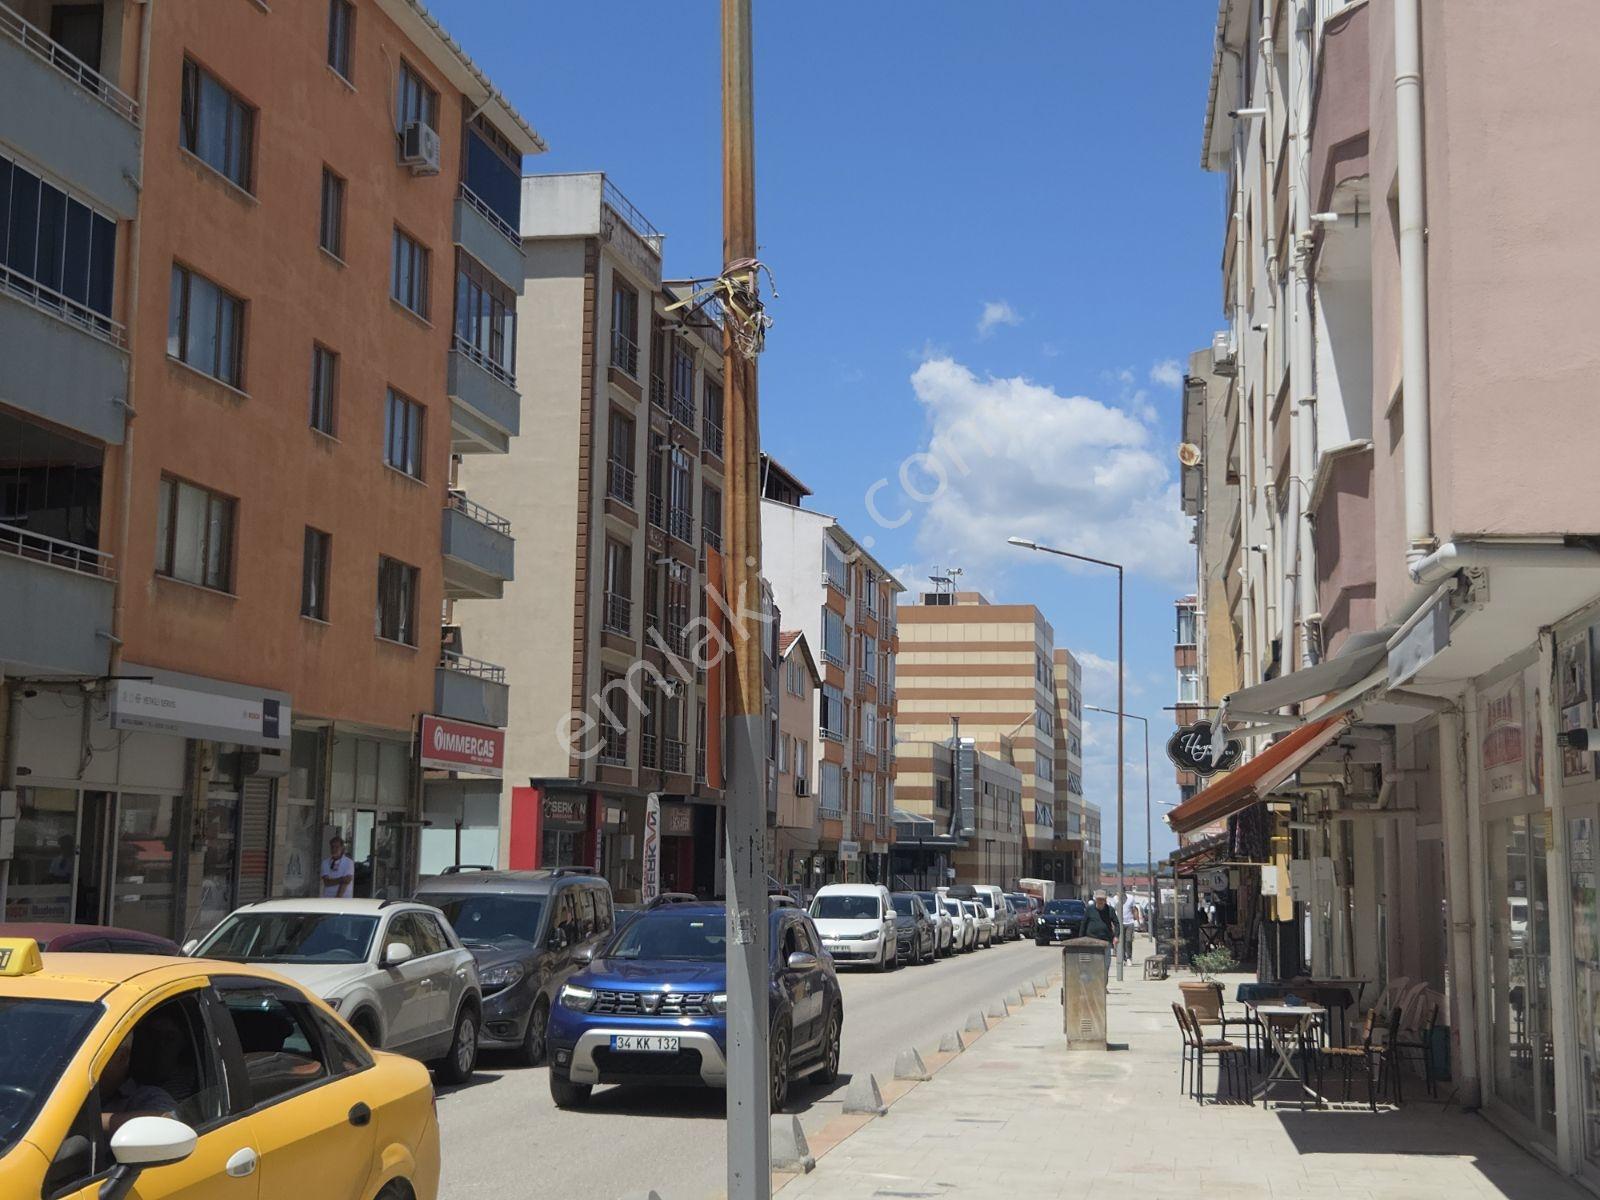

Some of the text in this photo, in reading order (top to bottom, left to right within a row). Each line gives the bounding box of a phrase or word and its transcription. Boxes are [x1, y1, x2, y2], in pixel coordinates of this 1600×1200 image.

[442, 732, 496, 758] IMMERGAS
[617, 1036, 677, 1050] 34 KK 132
